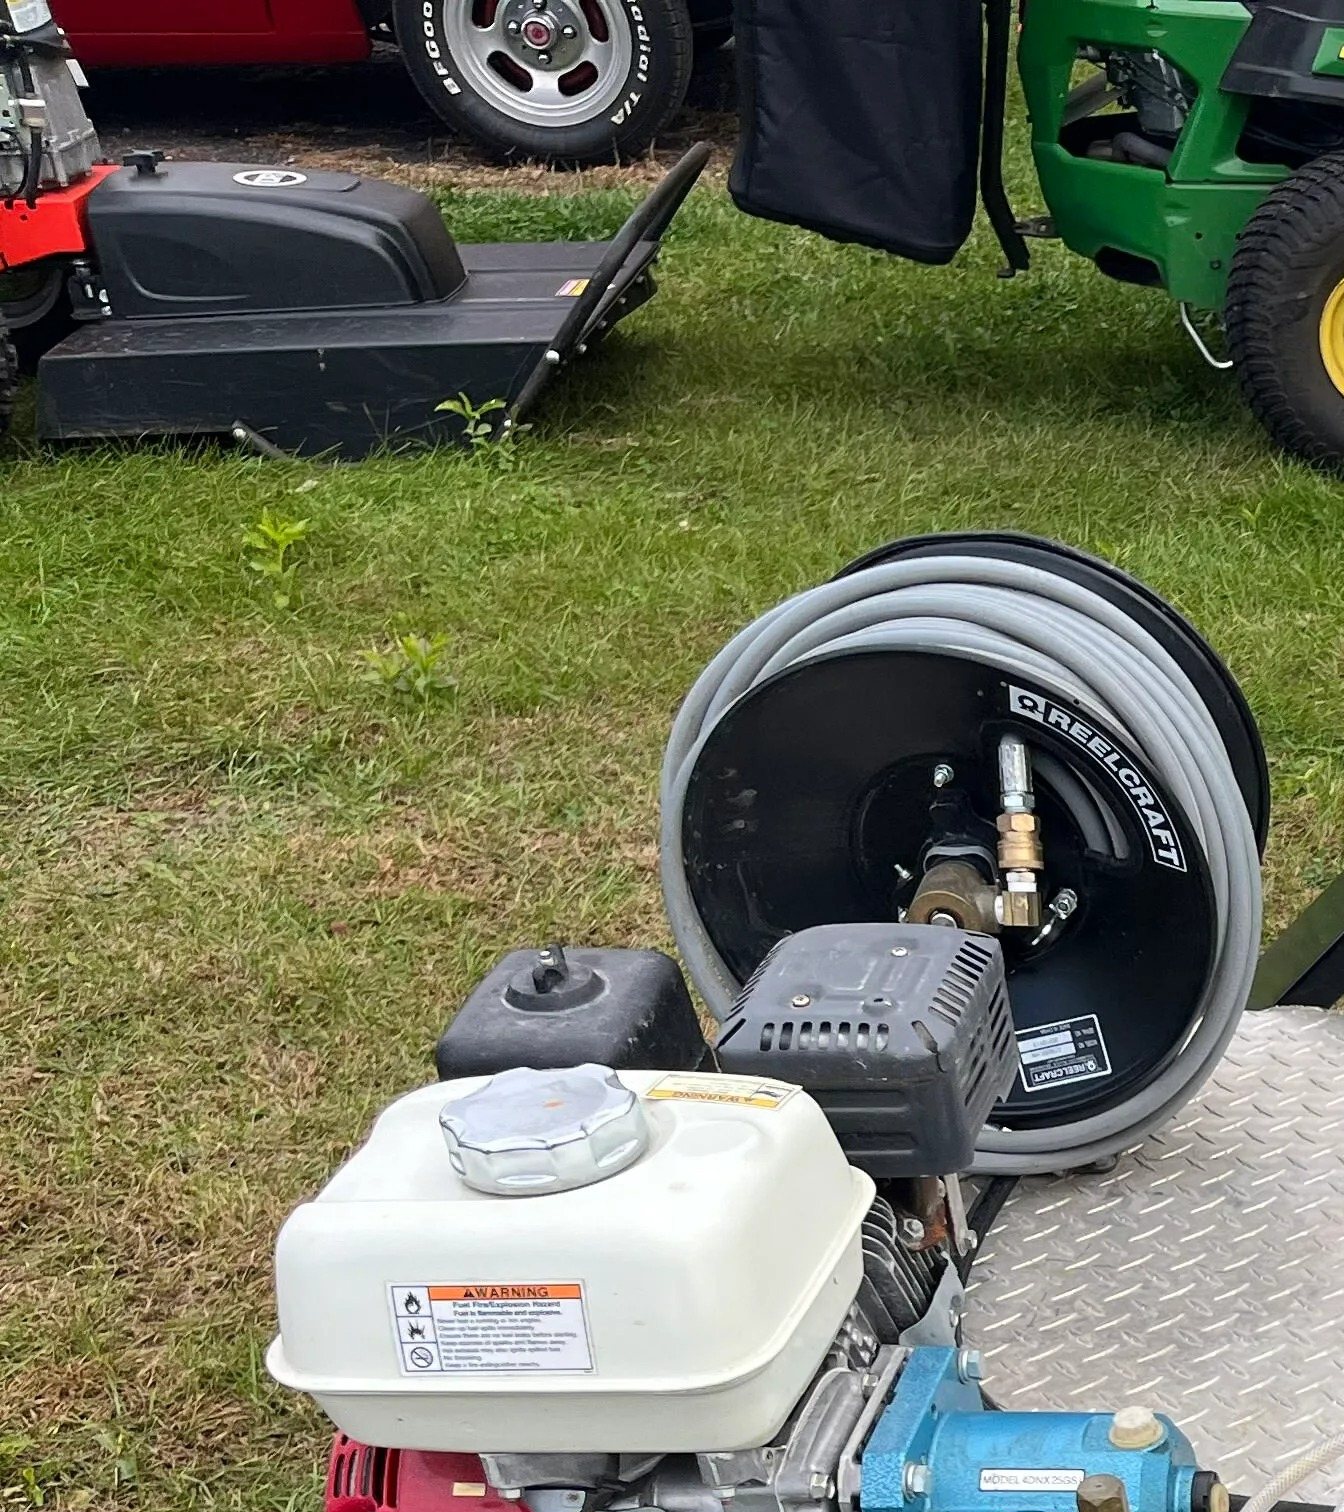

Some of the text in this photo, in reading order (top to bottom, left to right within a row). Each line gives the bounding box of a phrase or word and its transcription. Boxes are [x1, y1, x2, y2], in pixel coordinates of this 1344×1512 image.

[627, 0, 651, 82] adial
[1048, 709, 1180, 867] REELCRAFT
[1033, 1062, 1086, 1083] REELCRAFT
[671, 1091, 740, 1104] WARNING
[476, 1287, 549, 1298] WARNING
[983, 1474, 1020, 1485] MODEL
